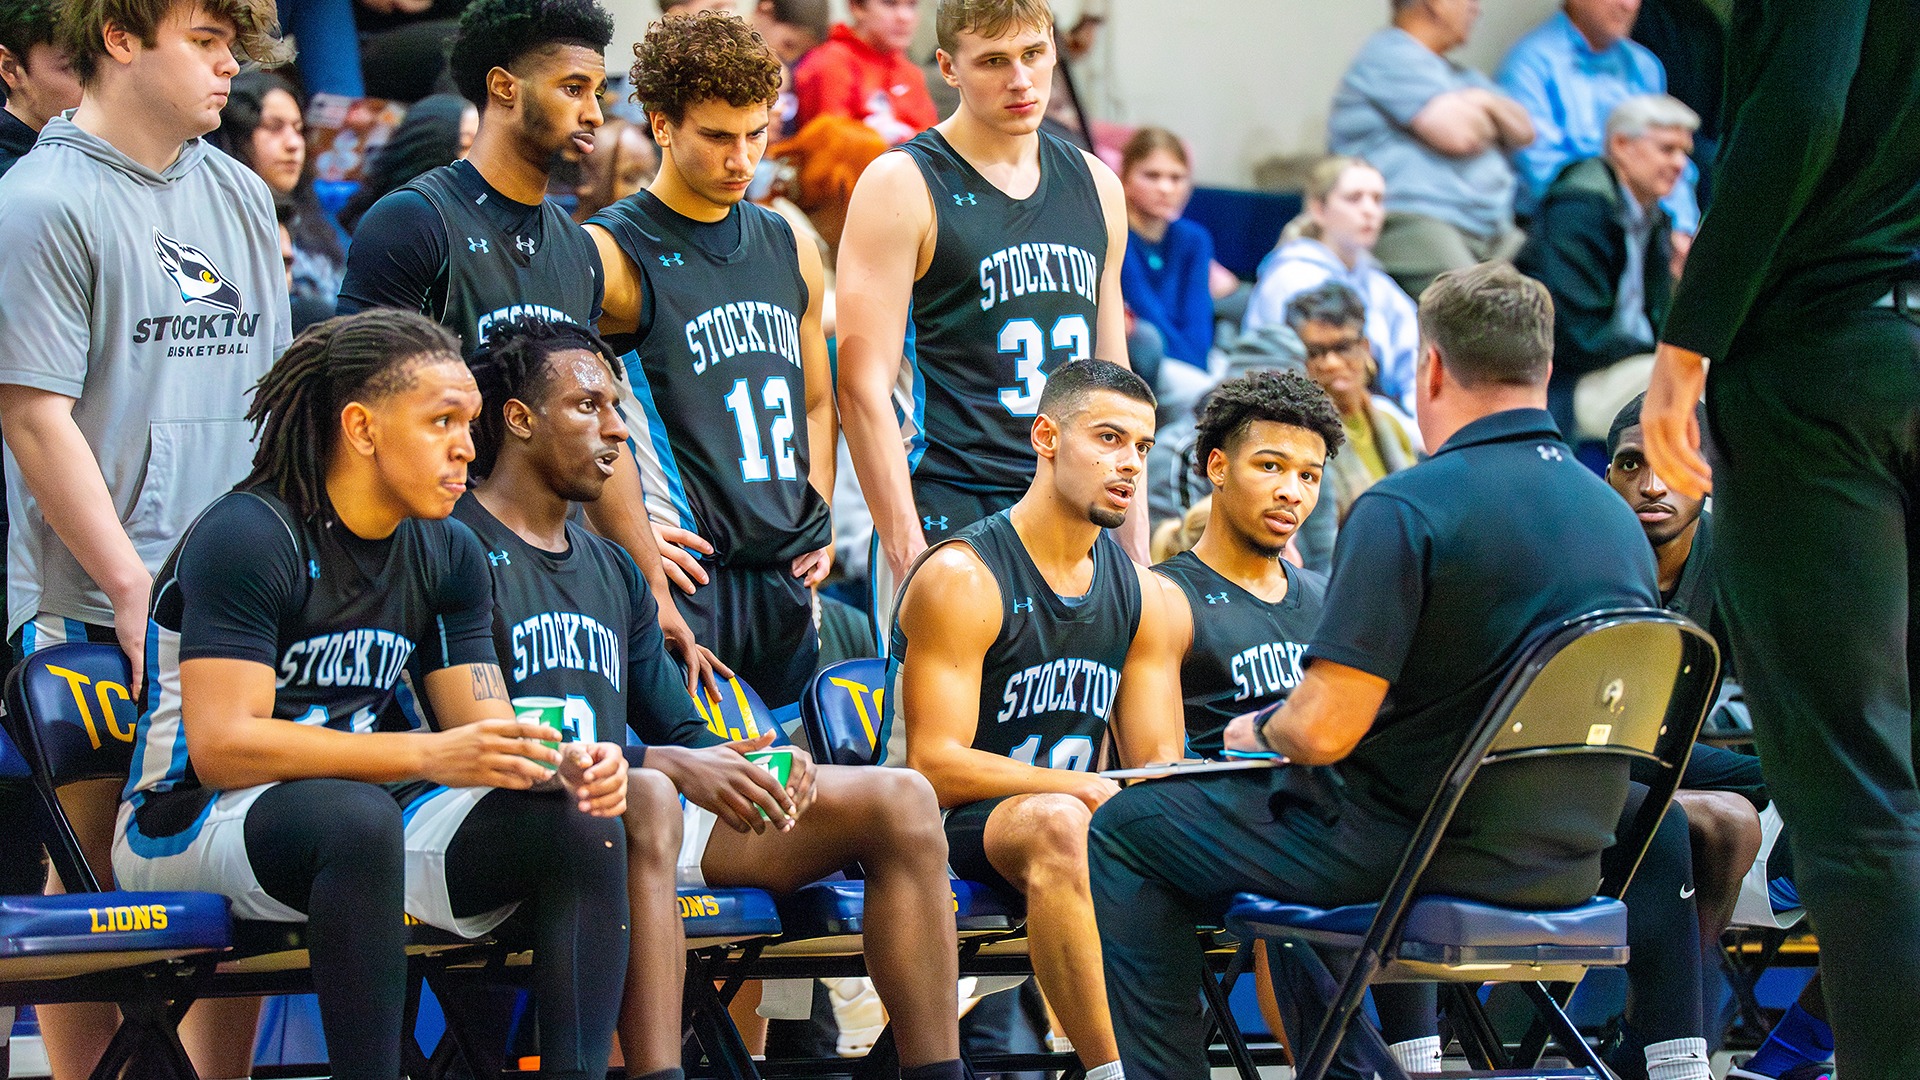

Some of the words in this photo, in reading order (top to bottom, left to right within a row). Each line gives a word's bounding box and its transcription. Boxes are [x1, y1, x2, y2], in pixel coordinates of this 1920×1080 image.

[979, 242, 1097, 311] STOCKTON
[132, 311, 261, 344] STOCKTON
[685, 300, 802, 376] STOCKTON
[723, 375, 797, 483] 12
[511, 610, 621, 694] STOCKTON
[997, 657, 1122, 724] STOCKTON
[88, 904, 168, 933] LIONS
